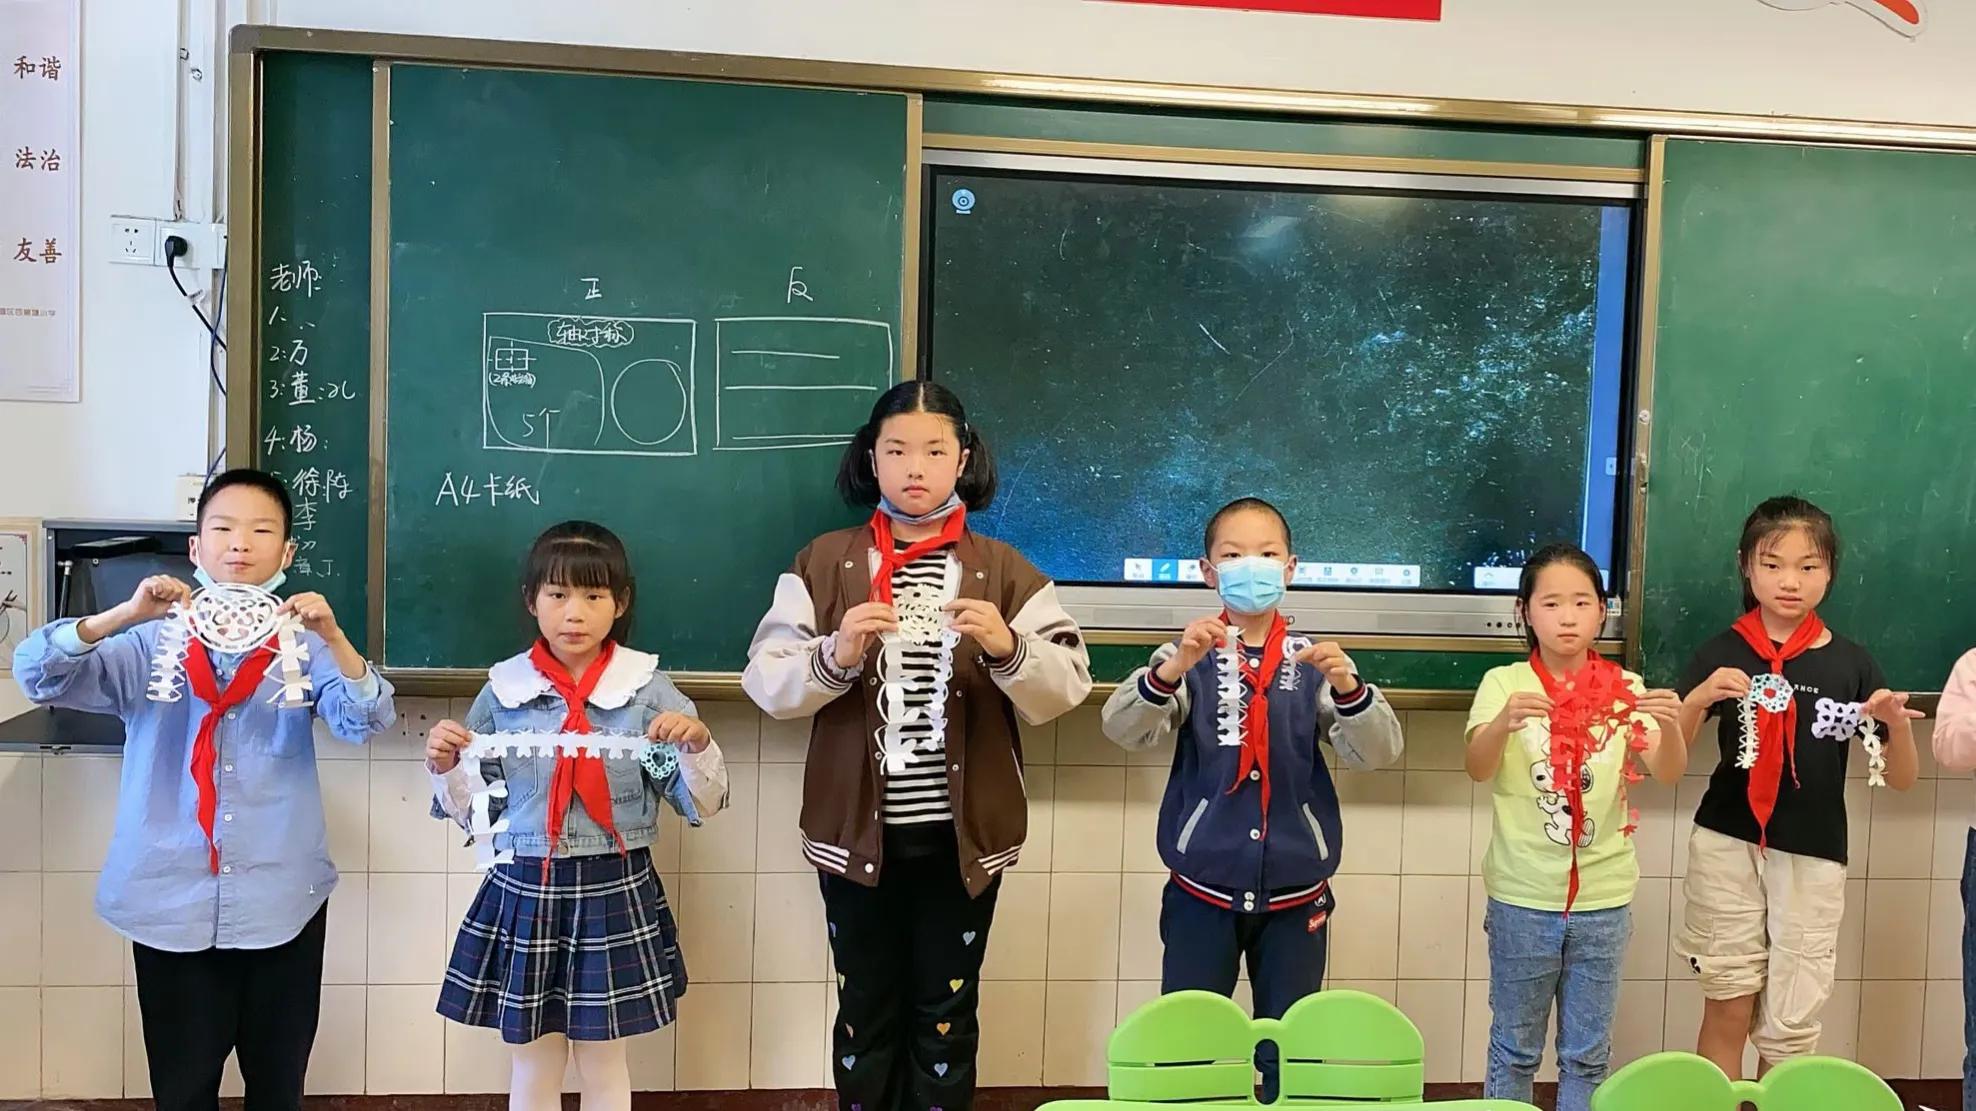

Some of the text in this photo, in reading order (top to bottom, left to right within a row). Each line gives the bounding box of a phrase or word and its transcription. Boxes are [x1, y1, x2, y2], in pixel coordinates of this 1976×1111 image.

[13, 56, 62, 81] 和谐
[15, 147, 62, 172] 法治
[13, 238, 62, 264] 友善
[581, 277, 602, 299] 正
[787, 266, 814, 303] 反
[556, 321, 628, 345] 轴对称
[523, 407, 561, 448] 5个
[435, 472, 540, 506] A4卡纸
